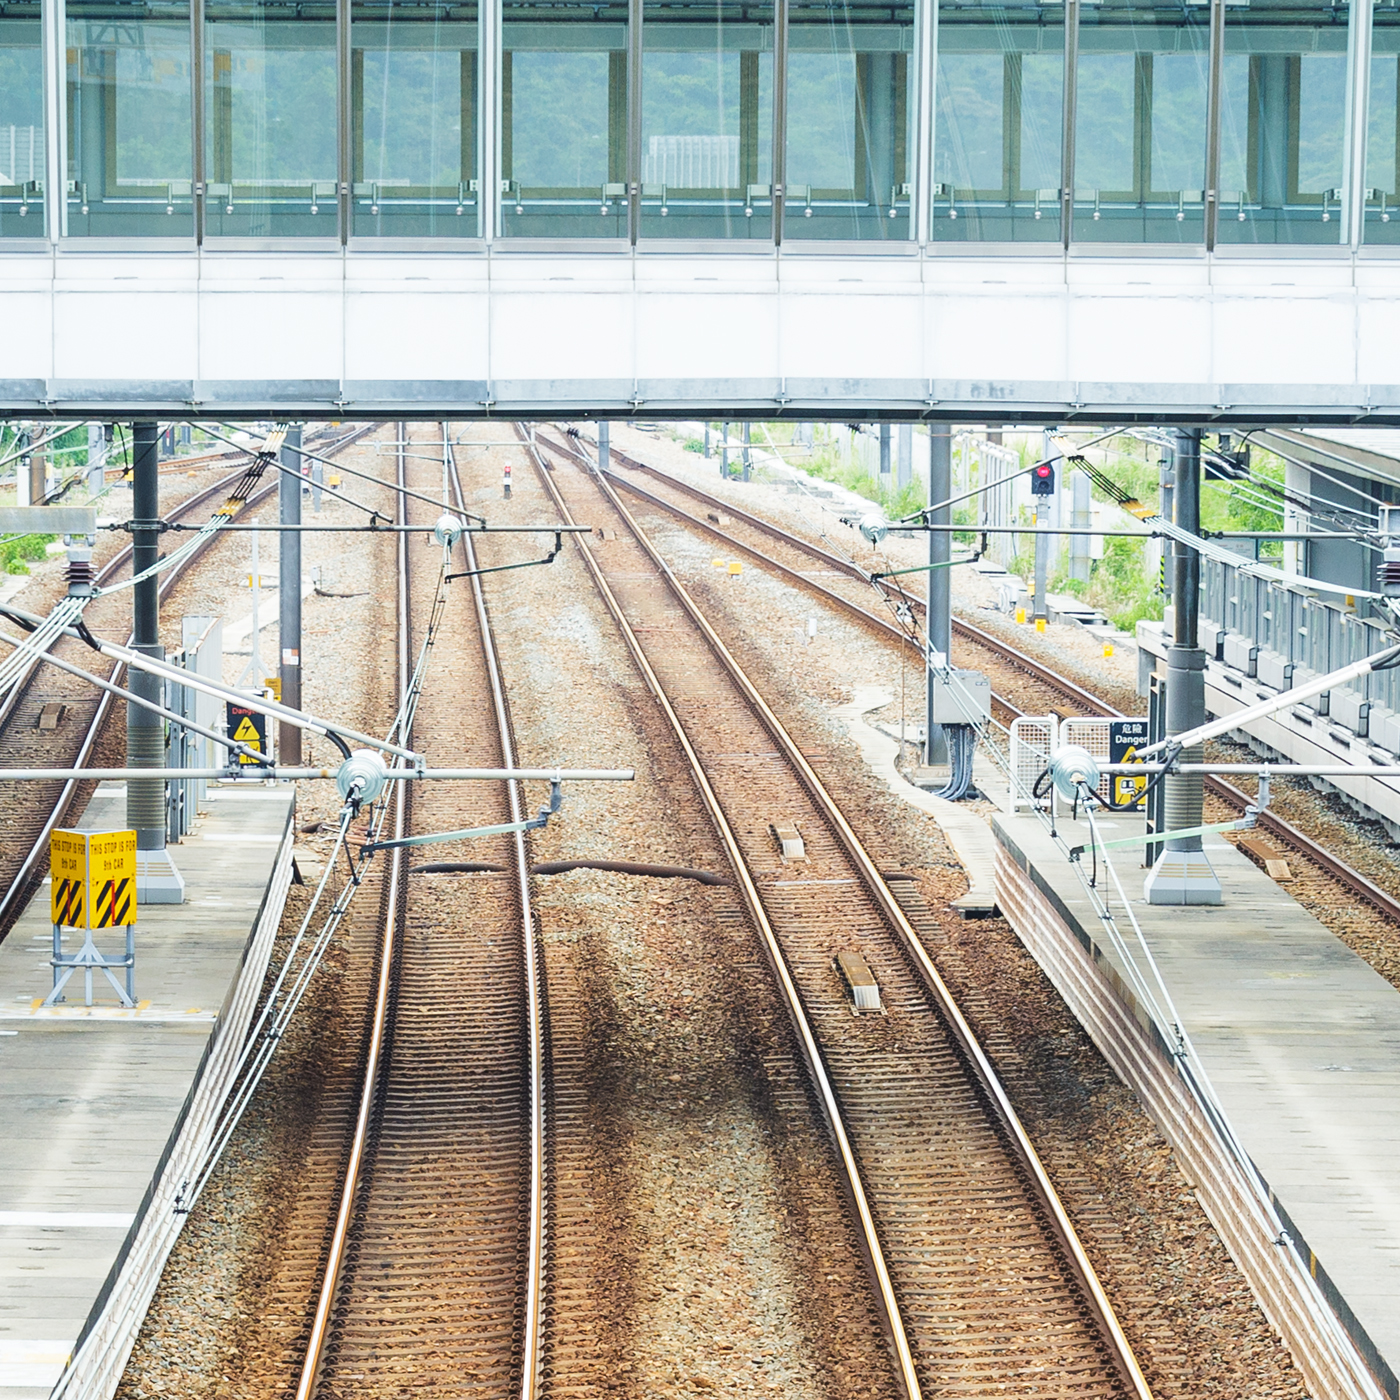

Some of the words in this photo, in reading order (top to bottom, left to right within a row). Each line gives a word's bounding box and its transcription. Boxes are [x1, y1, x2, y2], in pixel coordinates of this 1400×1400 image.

[232, 707, 257, 716] Dang
[1122, 723, 1142, 734] 危險
[62, 841, 71, 853] STOP
[90, 843, 102, 855] THIS
[104, 842, 117, 854] STOP
[119, 841, 124, 853] IS
[126, 840, 136, 852] FOR
[114, 858, 124, 870] CAR
